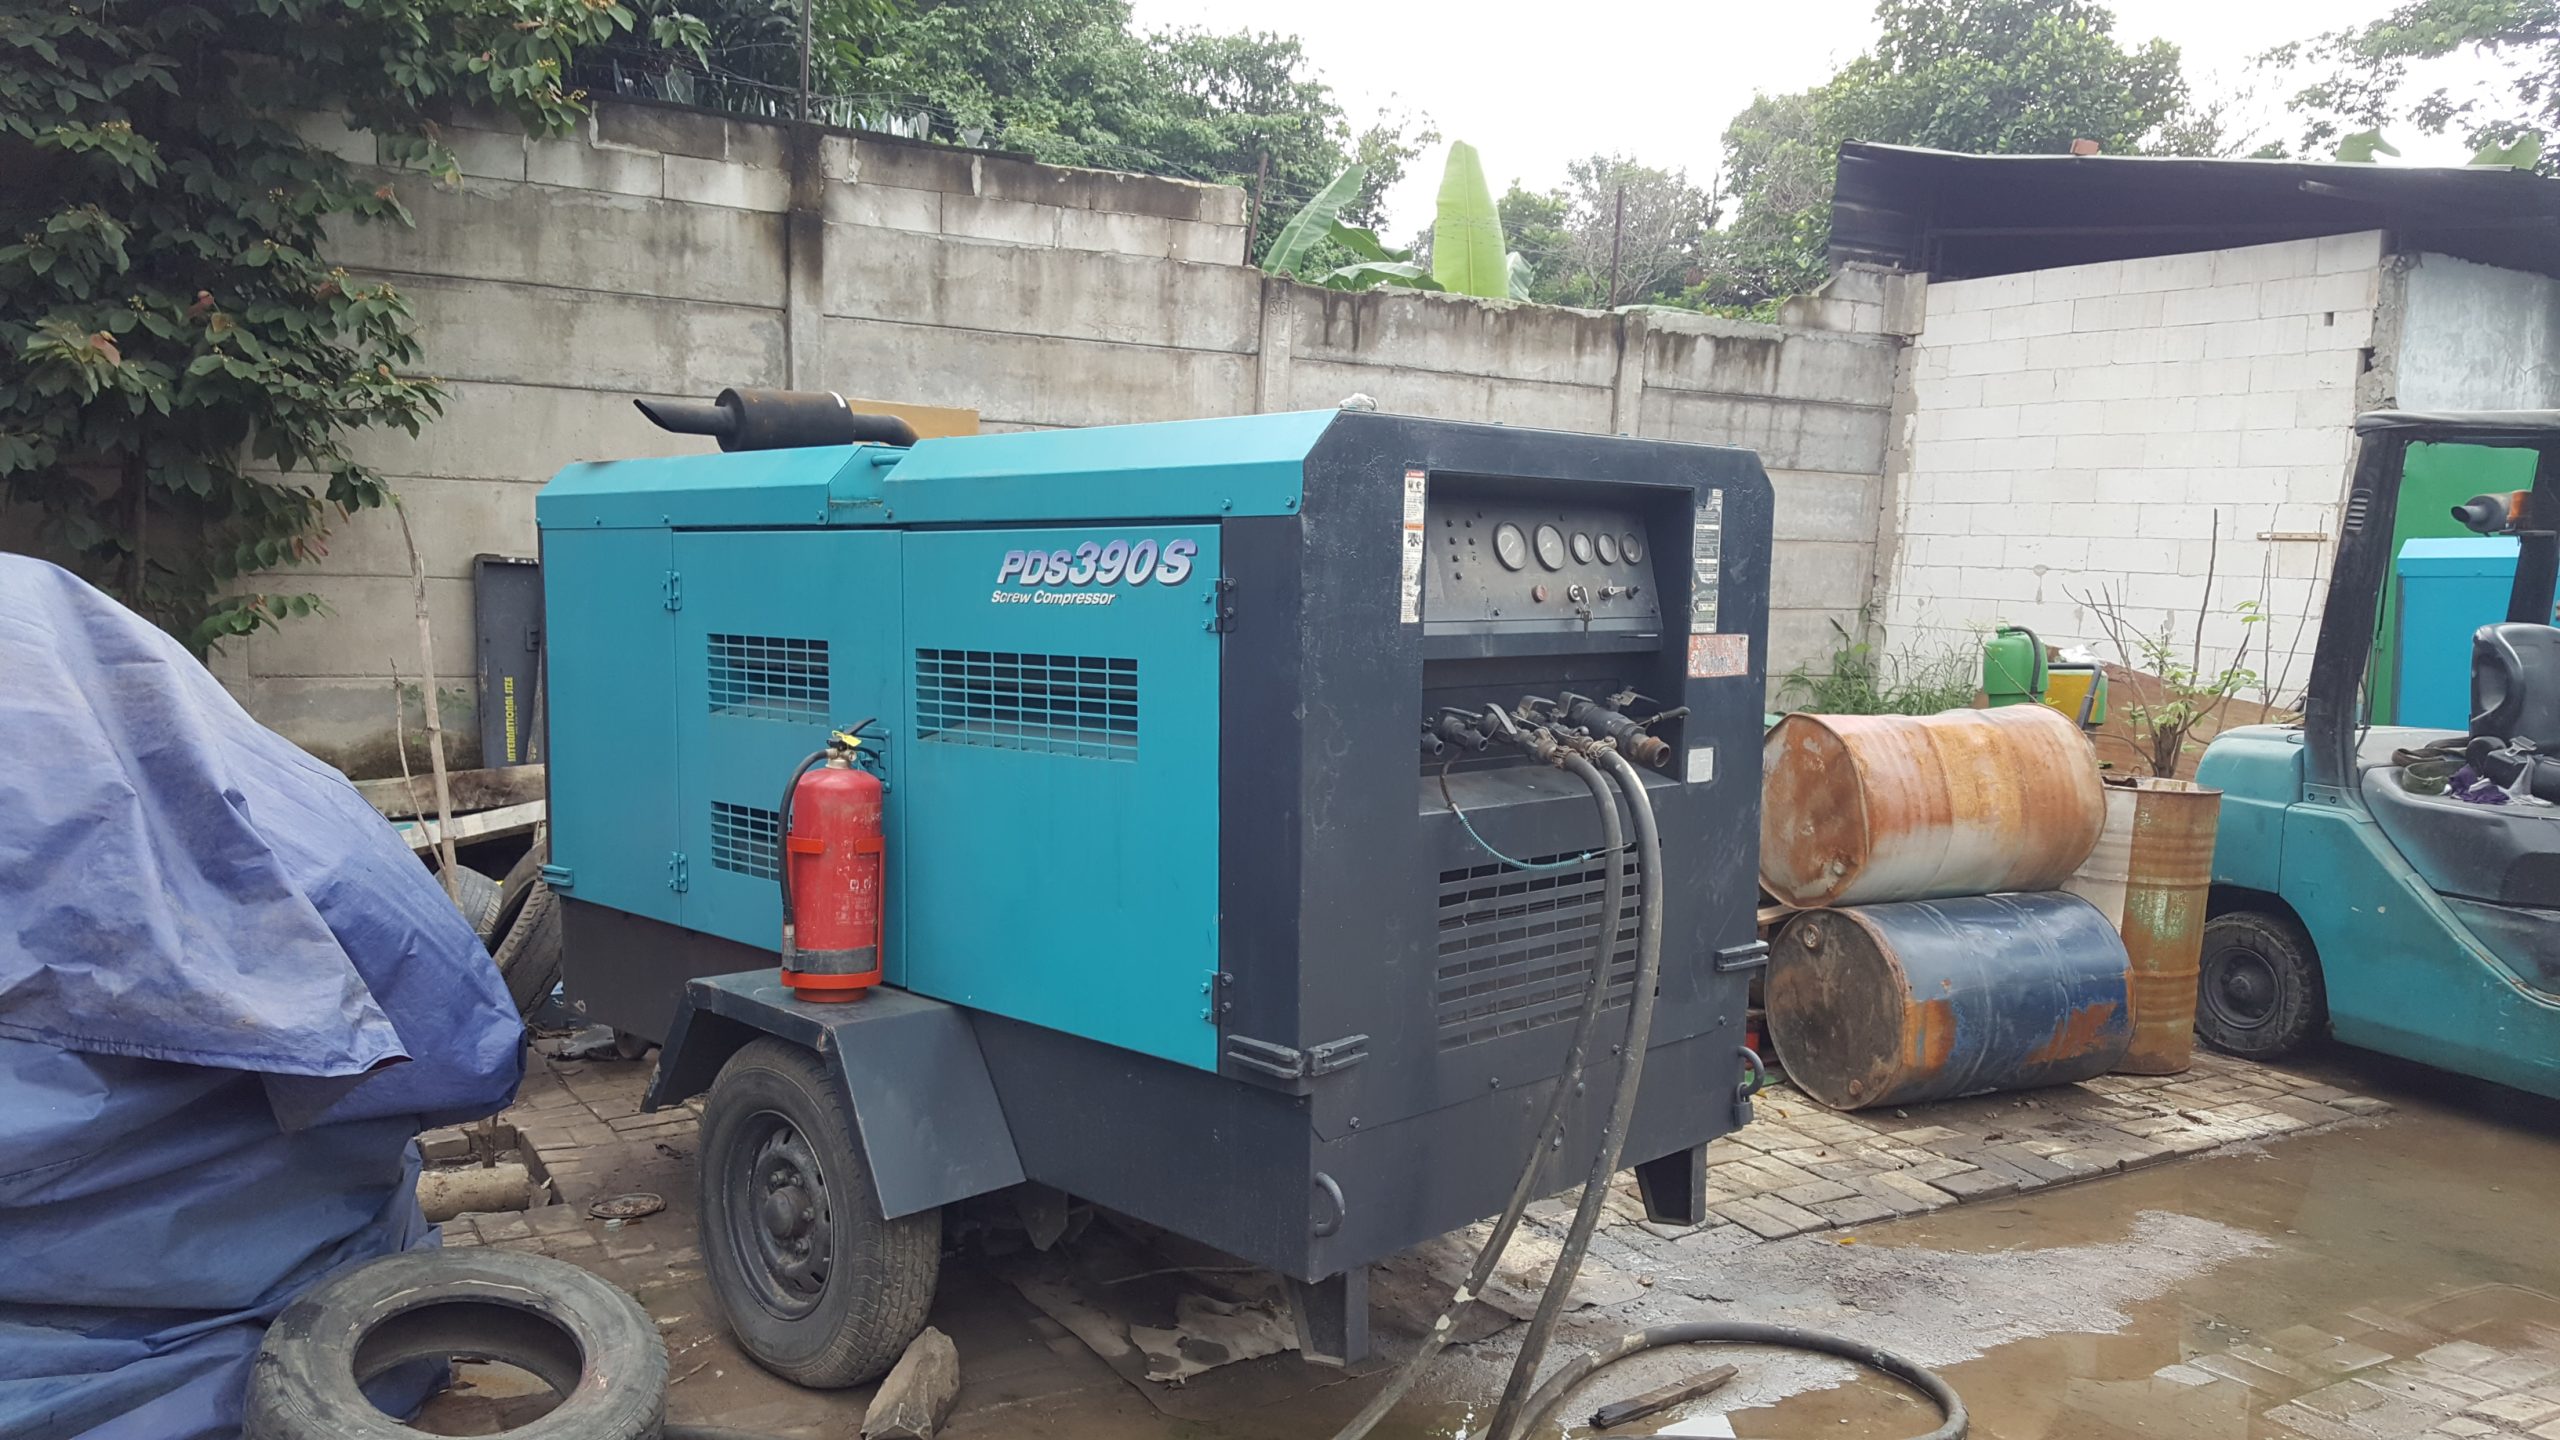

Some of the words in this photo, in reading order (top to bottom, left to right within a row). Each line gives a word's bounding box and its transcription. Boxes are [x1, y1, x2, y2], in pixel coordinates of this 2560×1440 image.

[997, 538, 1198, 586] PDS390S
[991, 590, 1032, 604] Screw
[1033, 589, 1115, 607] Compressor
[504, 677, 514, 694] SIZE
[505, 696, 516, 762] INTERNATIONAL
